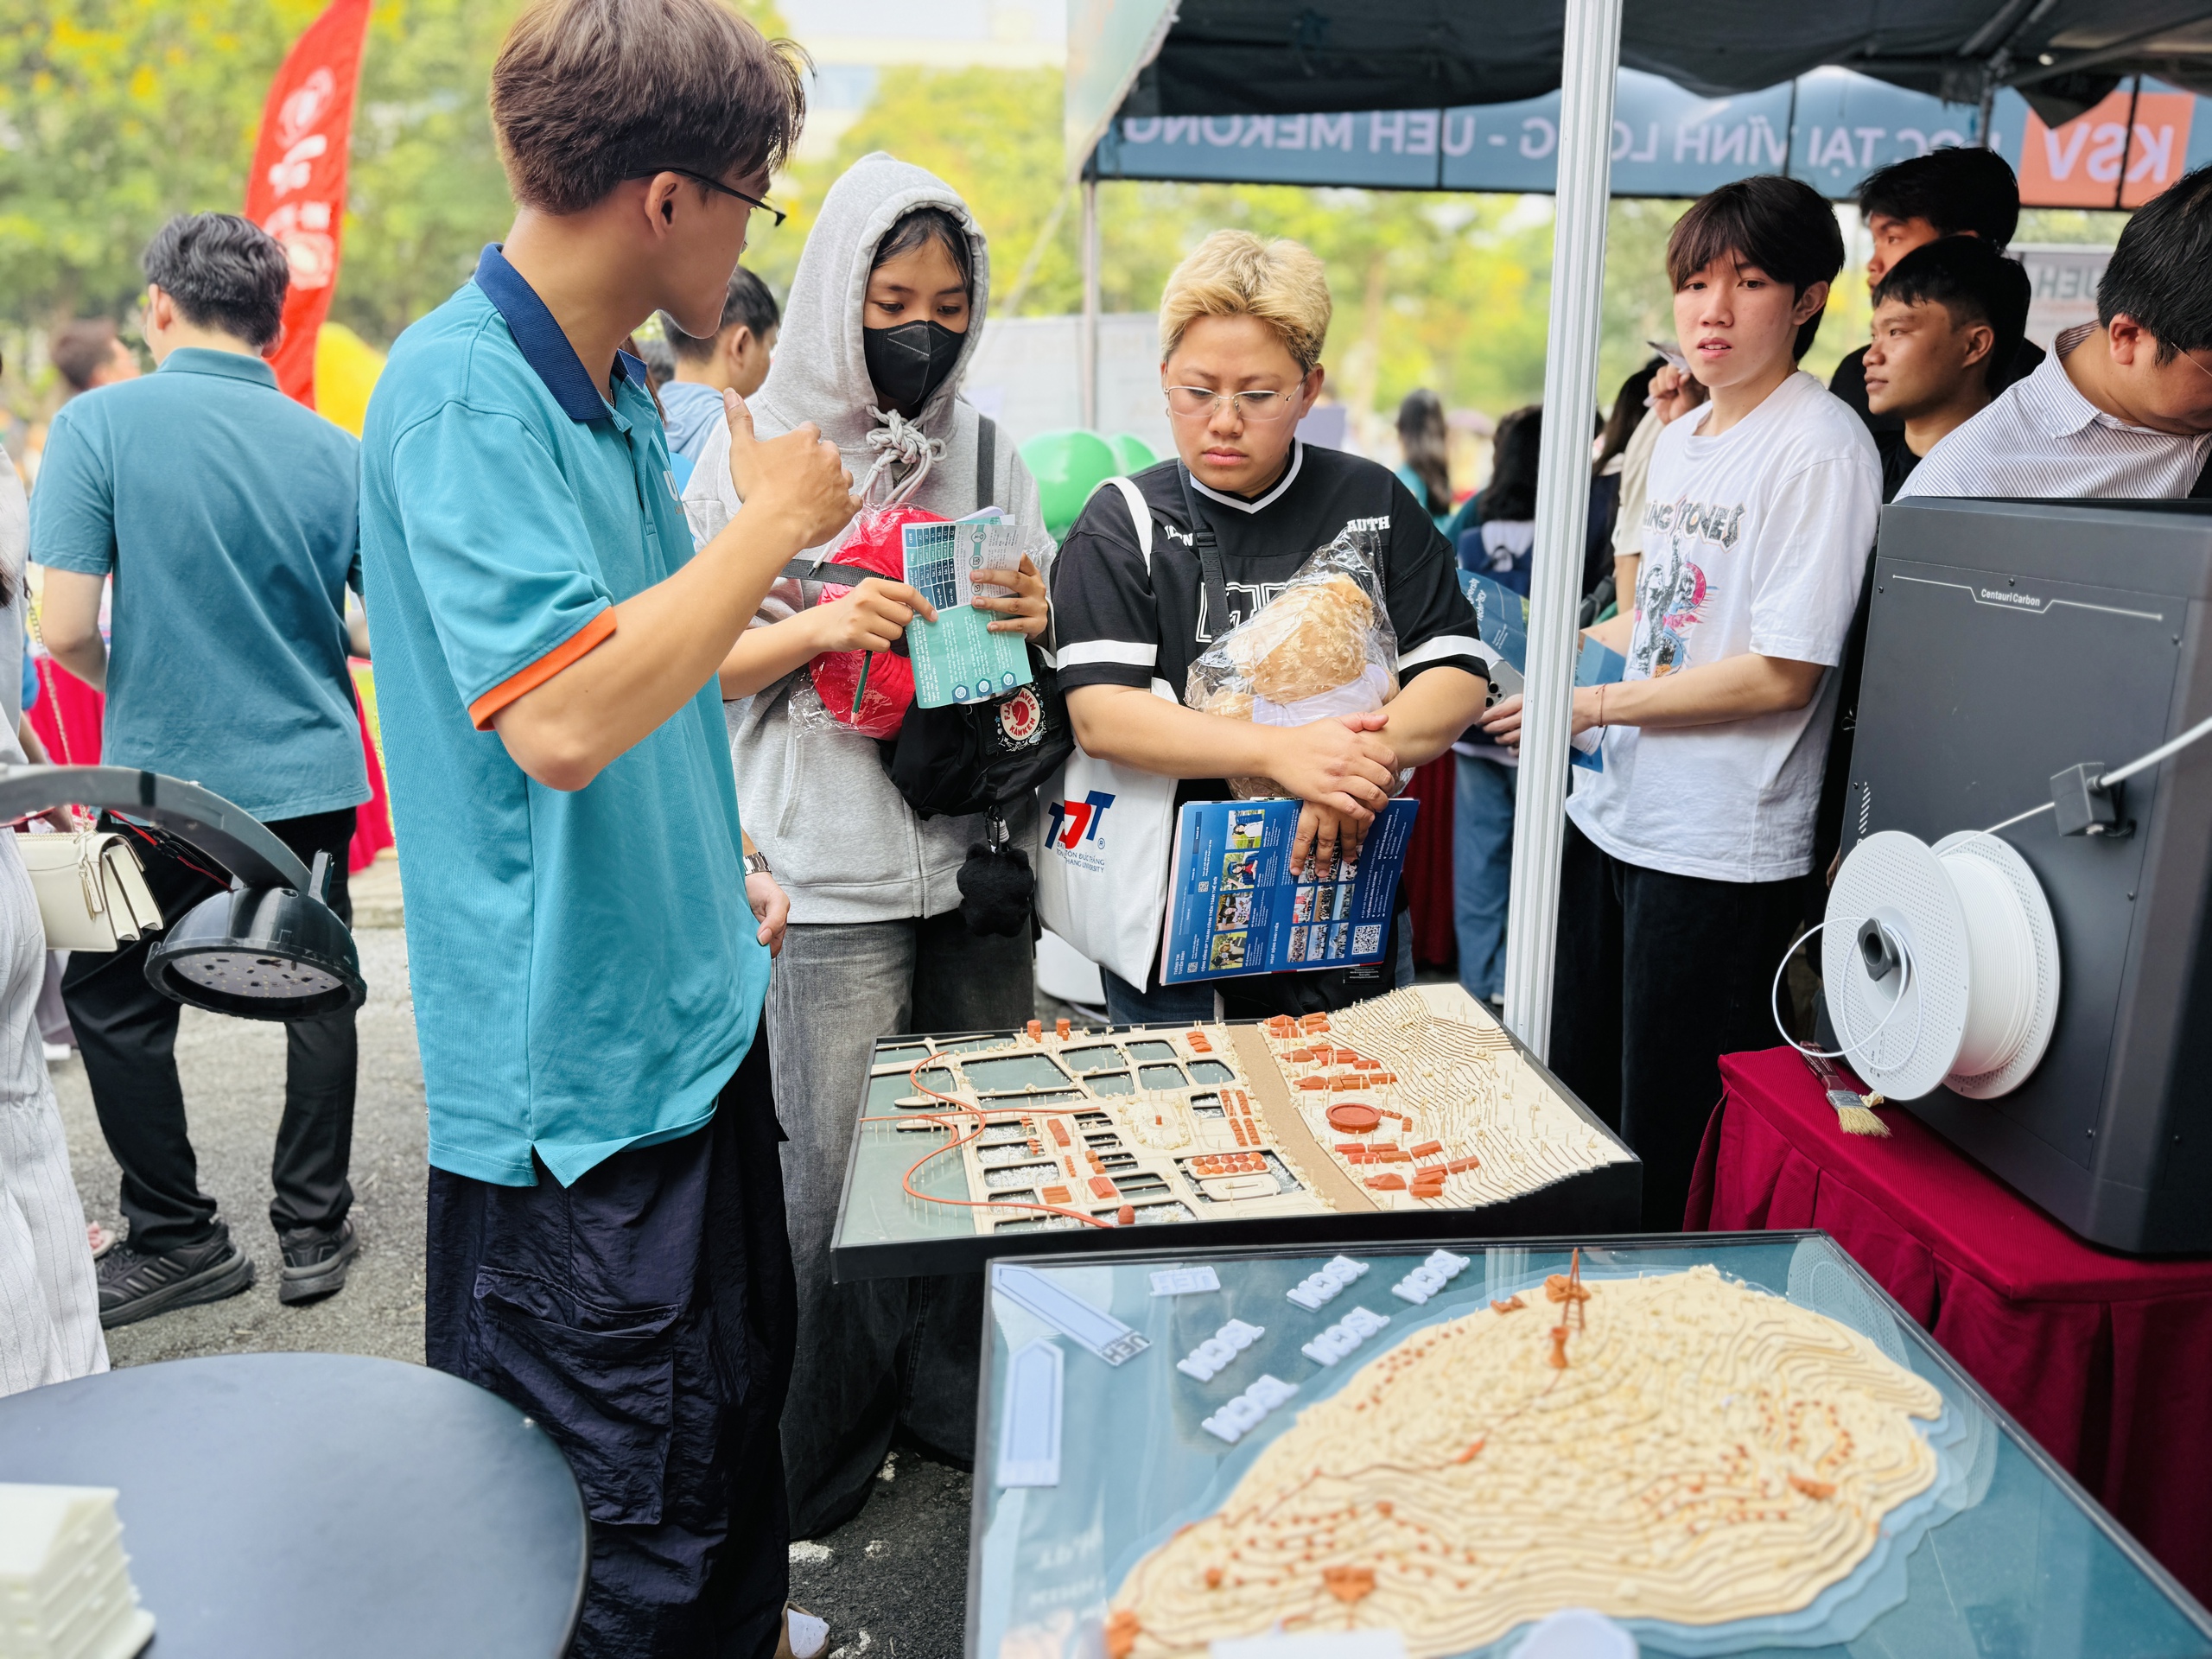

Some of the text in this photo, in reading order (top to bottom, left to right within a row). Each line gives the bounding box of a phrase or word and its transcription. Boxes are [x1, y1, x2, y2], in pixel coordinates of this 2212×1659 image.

[1981, 588, 2041, 607] Centauri Carbon
[1101, 1333, 1151, 1365] UEH
